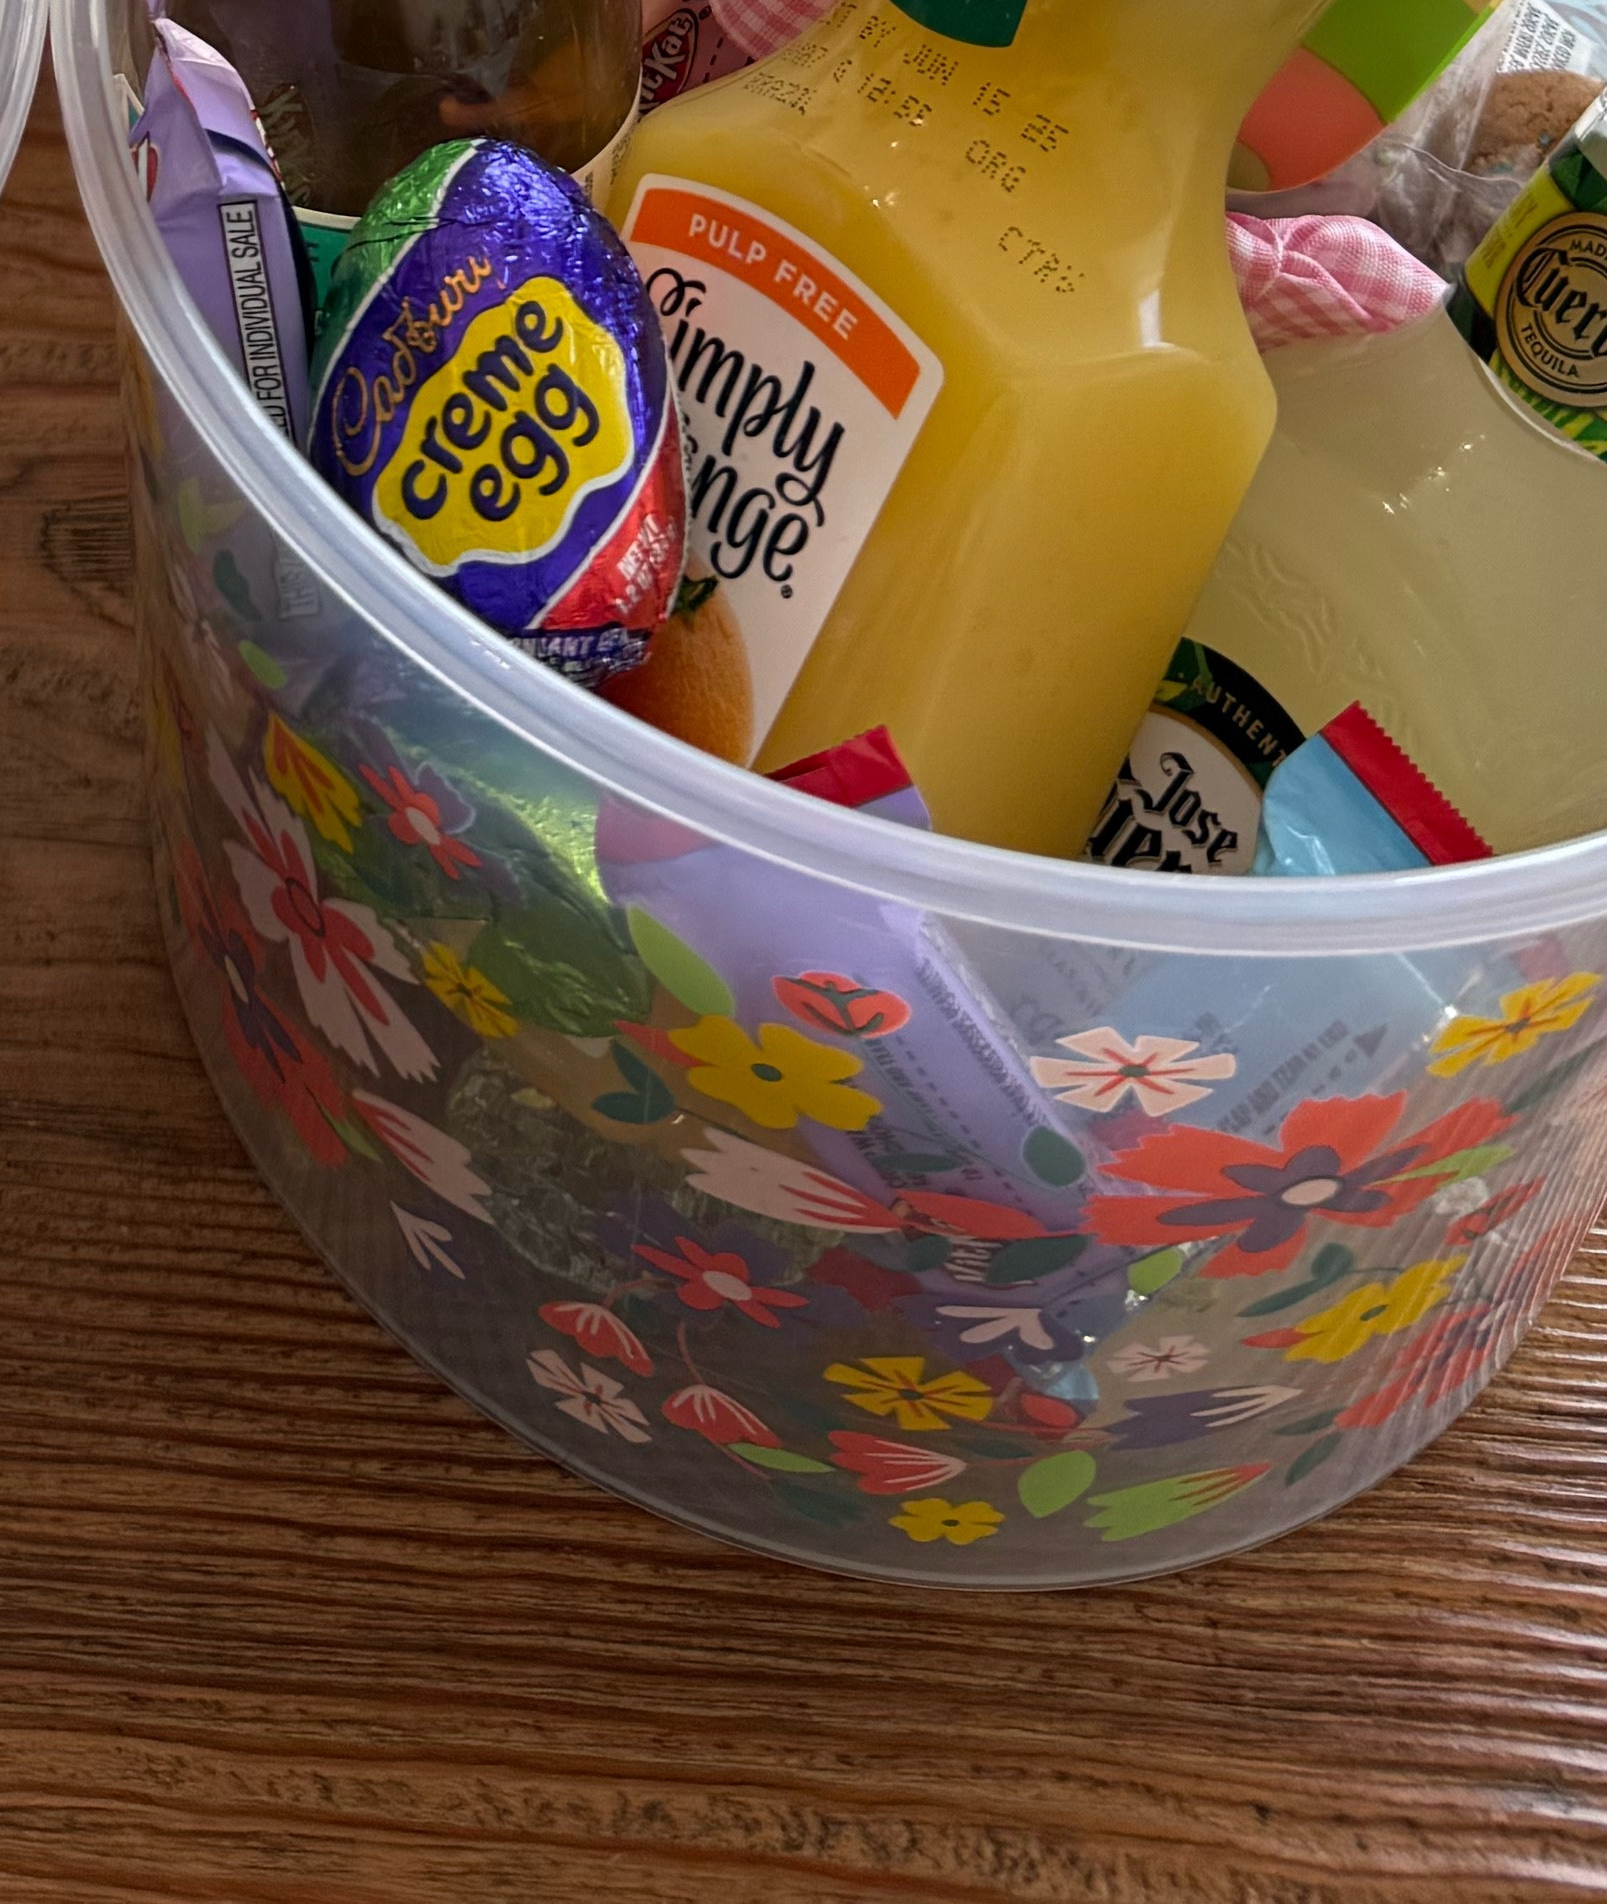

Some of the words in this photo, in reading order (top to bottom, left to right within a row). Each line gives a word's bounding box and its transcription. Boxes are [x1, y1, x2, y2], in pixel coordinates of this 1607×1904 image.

[903, 44, 959, 86] JUN
[226, 210, 260, 259] SALE
[688, 213, 767, 266] PULP
[774, 259, 858, 341] FREE
[1569, 238, 1607, 262] MAD
[234, 261, 276, 360] INDIVIDUAL
[1521, 321, 1580, 379] TEQUILA
[252, 364, 283, 400] FOR
[401, 300, 564, 520] creme
[469, 363, 600, 522] egg
[1192, 677, 1289, 768] AUTHENT
[1134, 751, 1238, 866] Jose
